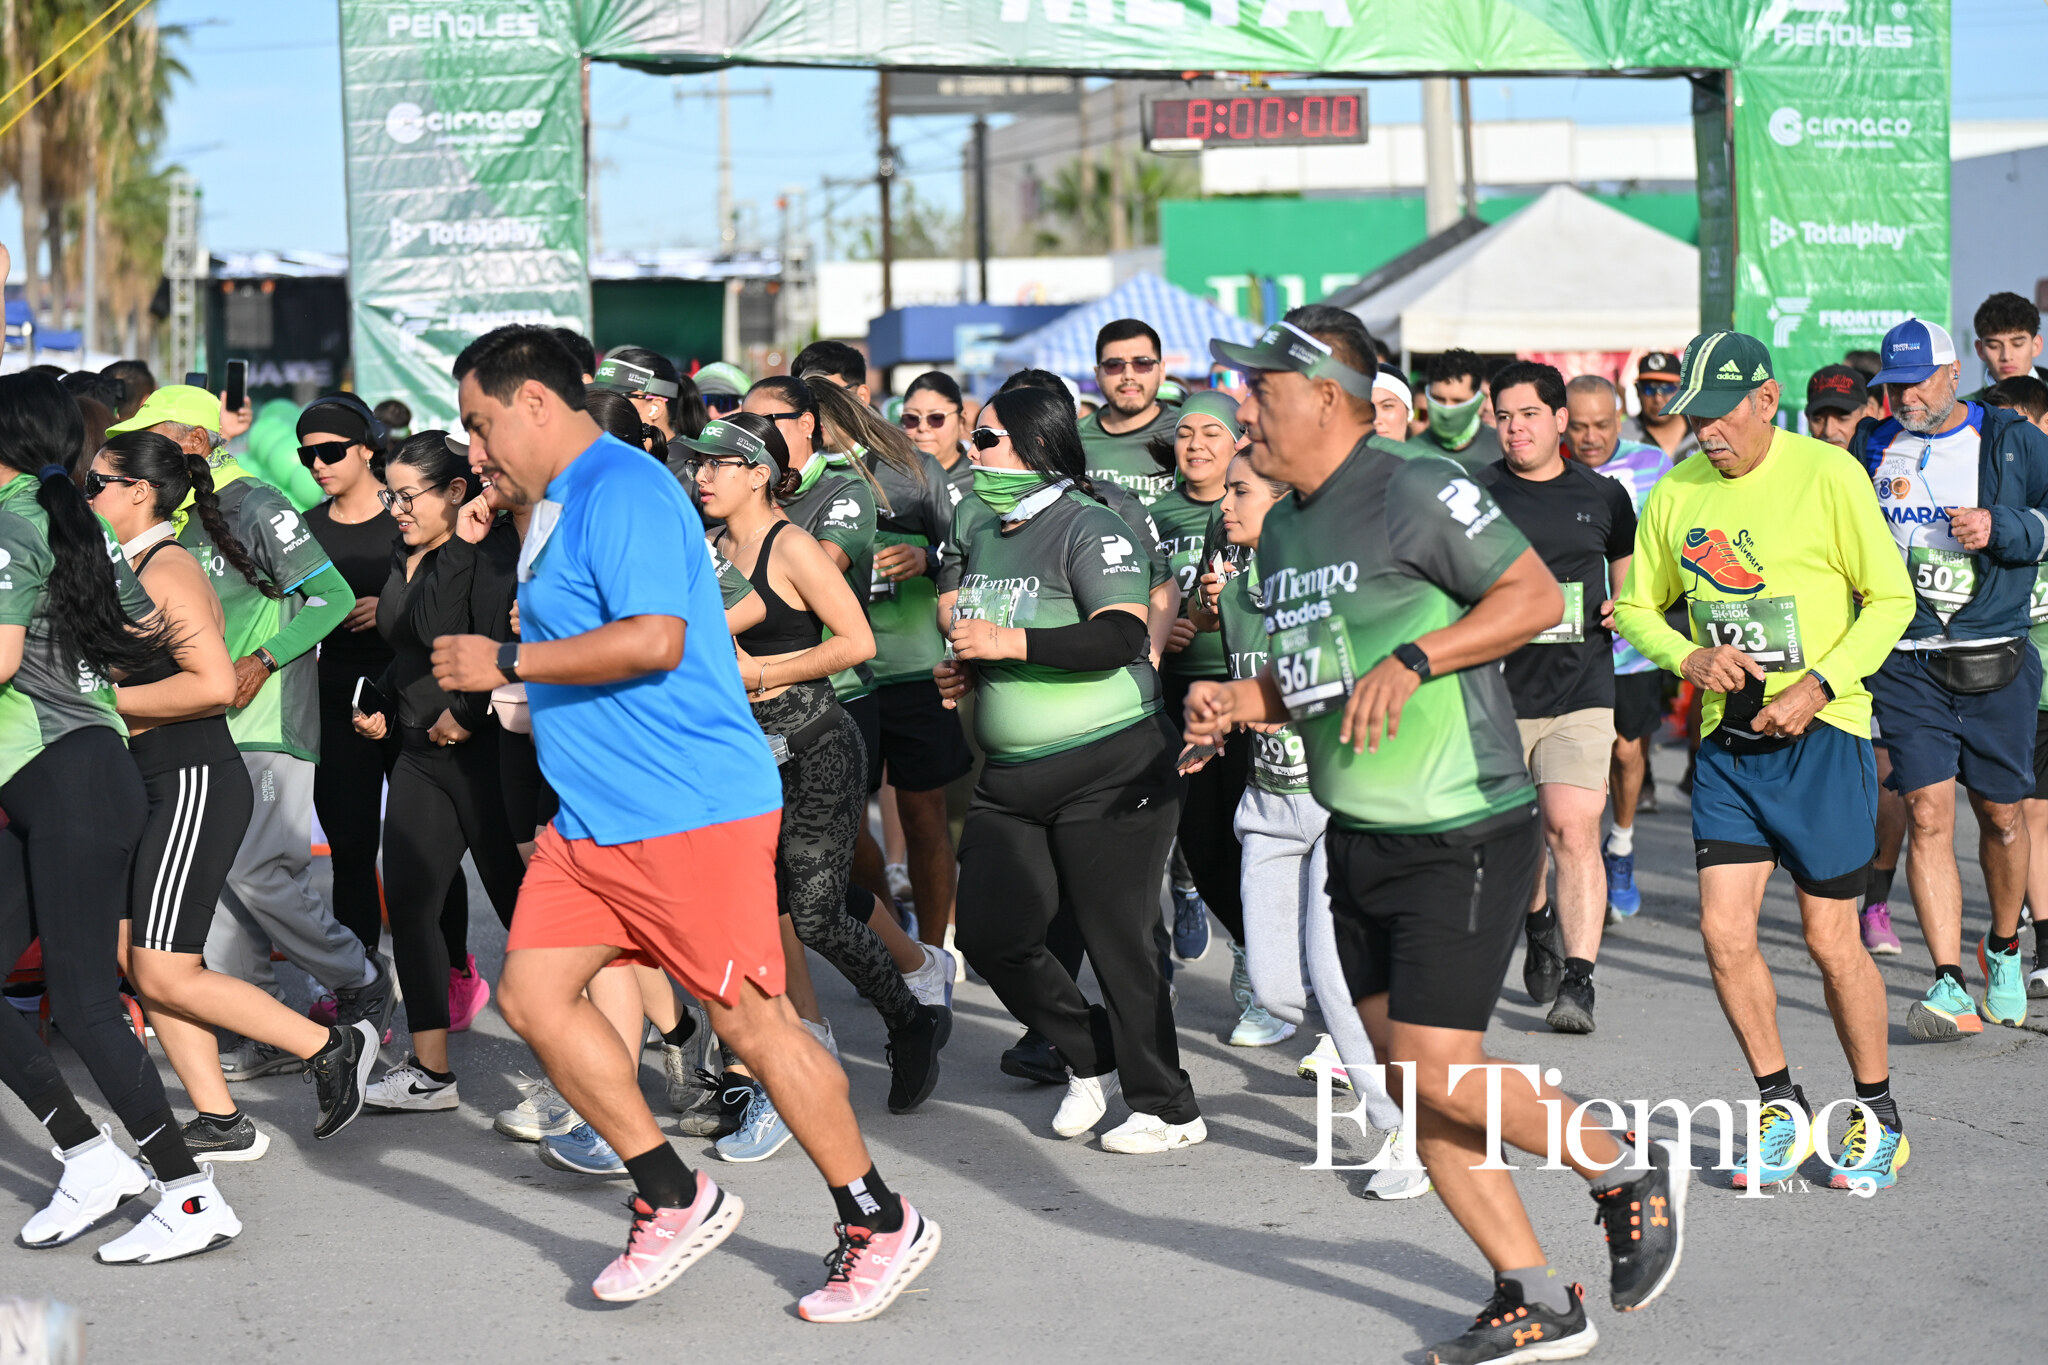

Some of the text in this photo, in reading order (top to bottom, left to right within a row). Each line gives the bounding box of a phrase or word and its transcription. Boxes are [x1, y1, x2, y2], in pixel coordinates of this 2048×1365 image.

[1799, 221, 1907, 251] Totalplay
[1716, 373, 1743, 381] adidas
[970, 574, 1040, 598] Tiempo
[1276, 561, 1359, 598] Tiempo
[1916, 563, 1974, 595] 502
[1275, 600, 1333, 629] todos
[1780, 601, 1794, 609] 123
[1706, 621, 1767, 652] 123
[1784, 613, 1800, 663] MEDALLA
[1277, 646, 1322, 695] 567
[1255, 733, 1306, 765] 299
[854, 1192, 882, 1216] NIKE
